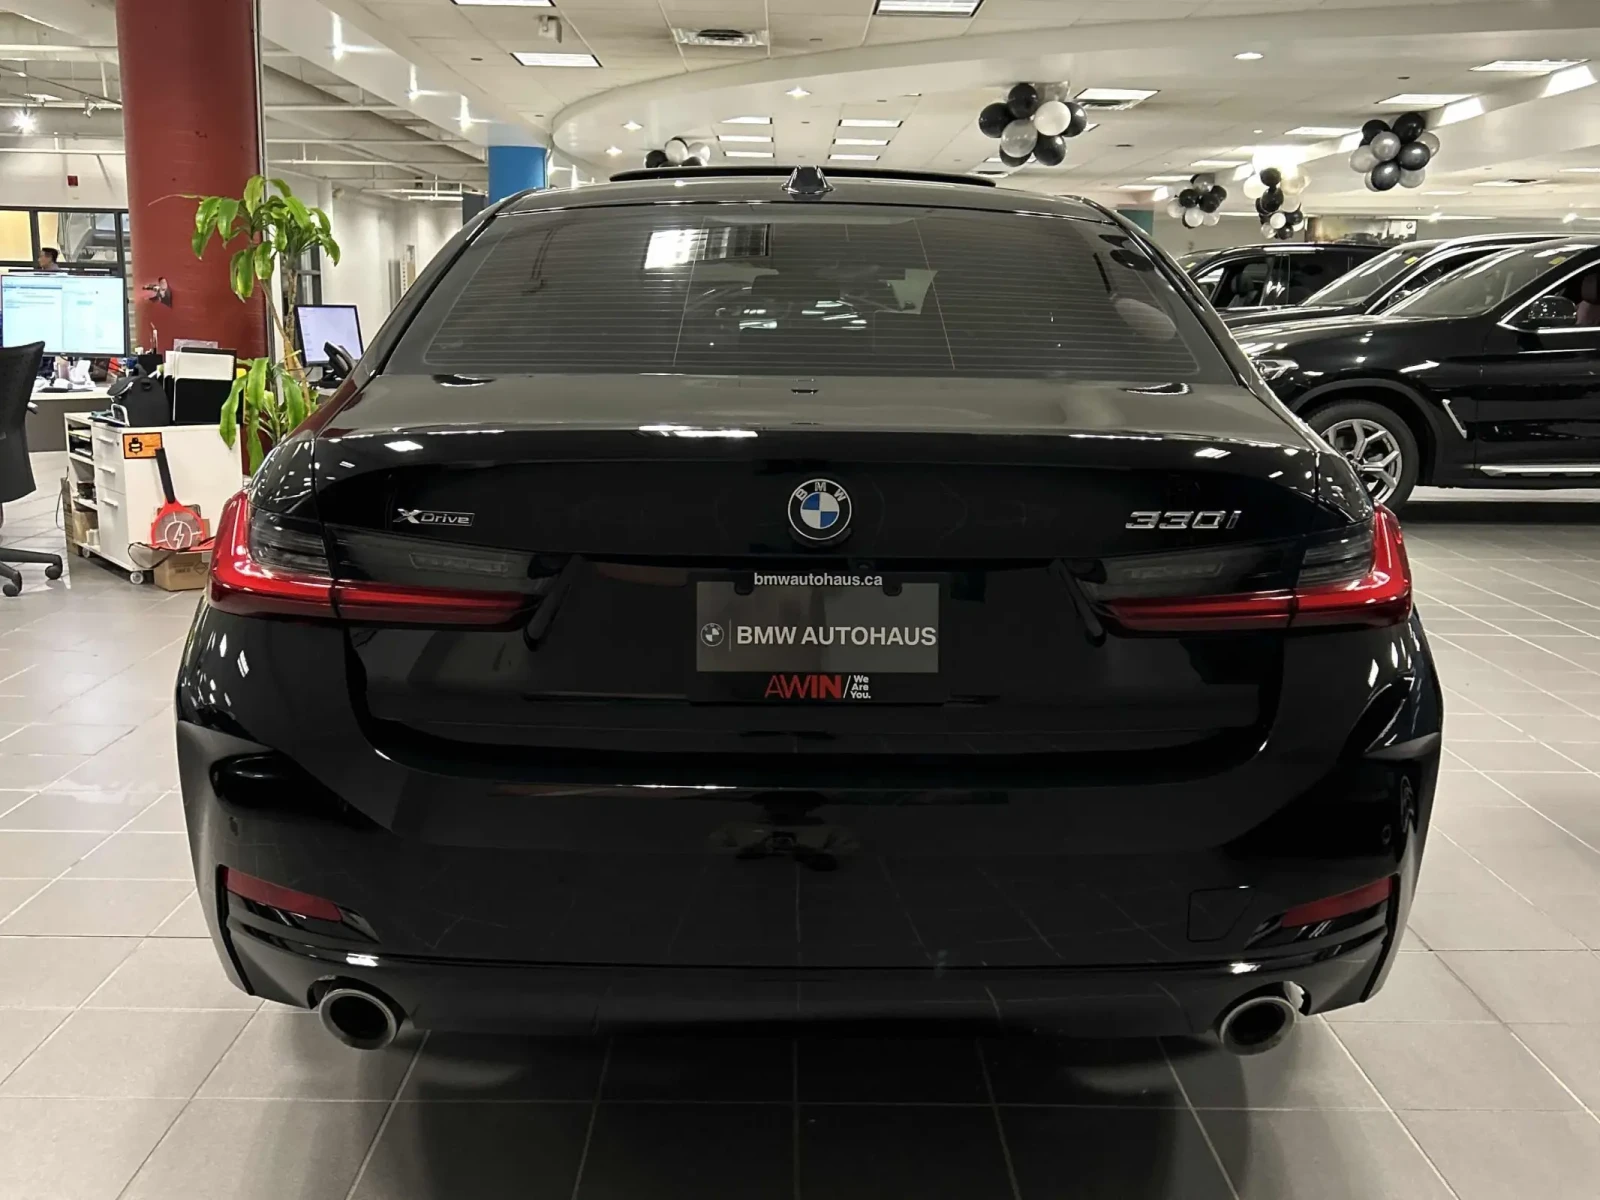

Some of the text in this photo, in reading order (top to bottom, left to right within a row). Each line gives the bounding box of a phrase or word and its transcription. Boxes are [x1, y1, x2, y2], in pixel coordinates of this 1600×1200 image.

[1125, 510, 1242, 529] 330i
[753, 573, 883, 586] bmwautohaus.ca
[737, 626, 797, 645] BMW
[801, 626, 937, 646] AUTOHAUS
[853, 674, 869, 683] We
[764, 674, 842, 699] AWIN
[851, 683, 869, 691] Are
[850, 691, 871, 699] You.
